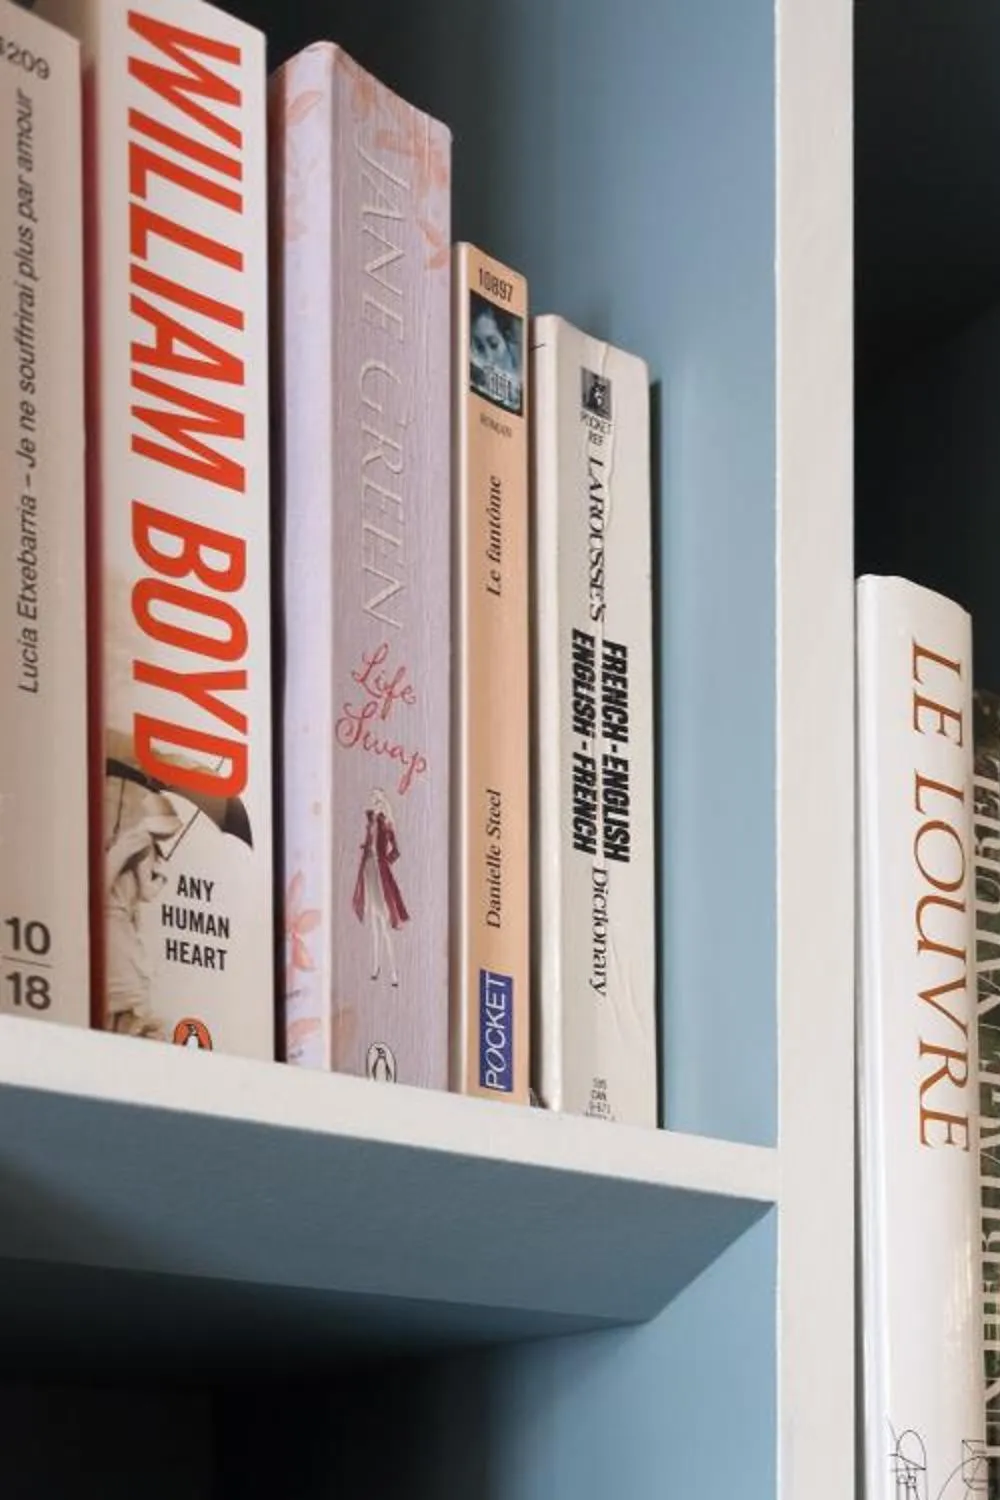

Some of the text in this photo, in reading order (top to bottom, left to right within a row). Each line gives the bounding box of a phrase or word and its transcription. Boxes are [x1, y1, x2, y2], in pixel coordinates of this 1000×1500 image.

[16, 87, 33, 172] amour
[18, 174, 37, 223] par
[14, 224, 39, 282] plus
[478, 267, 514, 303] 10897
[14, 280, 36, 395] souffrirai
[19, 400, 36, 432] ne
[127, 9, 249, 798] WILLIAM BOYD
[356, 137, 409, 629] JANE GREEN
[16, 437, 36, 469] Je
[17, 495, 38, 621] Etxebarria
[485, 475, 502, 597] Le fantôme
[351, 641, 417, 720] Life
[335, 702, 427, 795] Swap
[176, 873, 215, 903] ANY
[484, 789, 502, 929] Danielle Steel
[912, 637, 971, 1153] LE LOUVRE
[5, 915, 51, 957] 10
[161, 904, 231, 940] HUMAN
[165, 937, 229, 972] HEART
[588, 866, 610, 997] Dictionary
[5, 970, 51, 1012] 18
[483, 971, 512, 1090] POCKET
